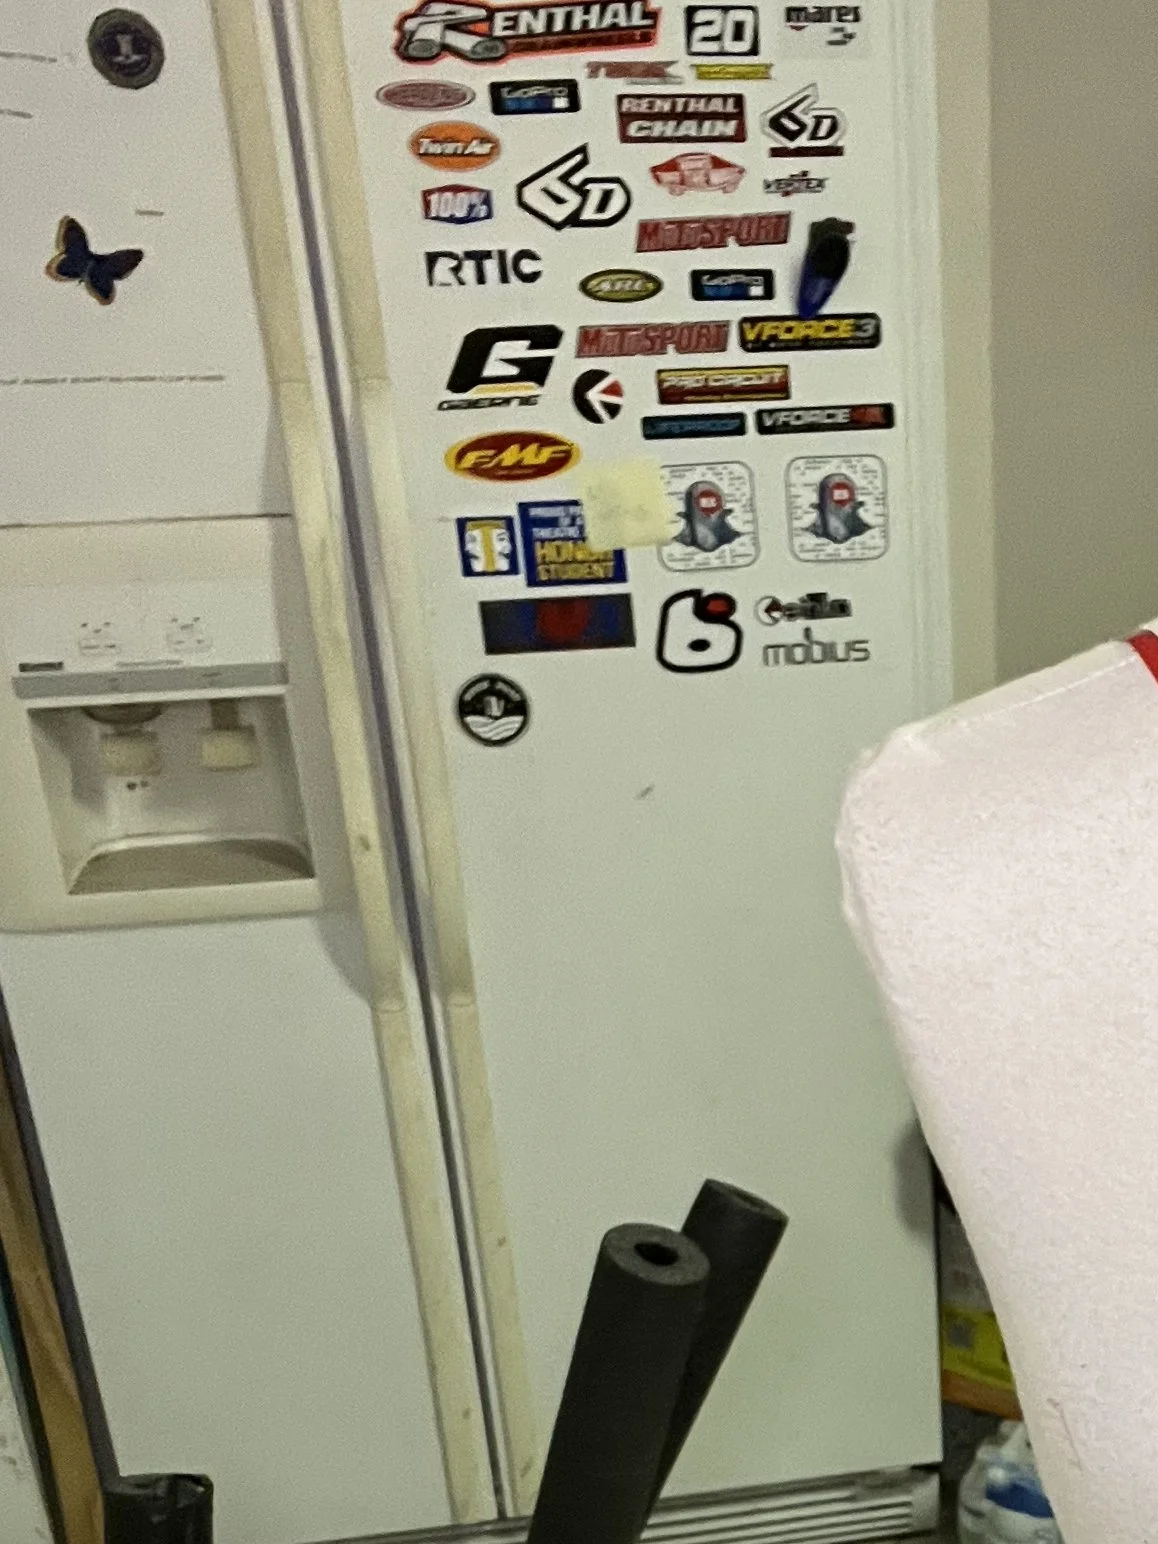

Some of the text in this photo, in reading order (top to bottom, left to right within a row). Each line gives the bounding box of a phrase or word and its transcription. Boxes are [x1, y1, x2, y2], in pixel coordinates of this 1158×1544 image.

[403, 1, 655, 59] RENTHAL
[690, 8, 755, 53] 20
[620, 96, 740, 113] RENTHAL
[626, 118, 738, 137] CHAIN
[427, 190, 490, 219] 100%
[424, 249, 543, 287] RTIC
[456, 441, 575, 470] FMF
[762, 626, 871, 667] mobius
